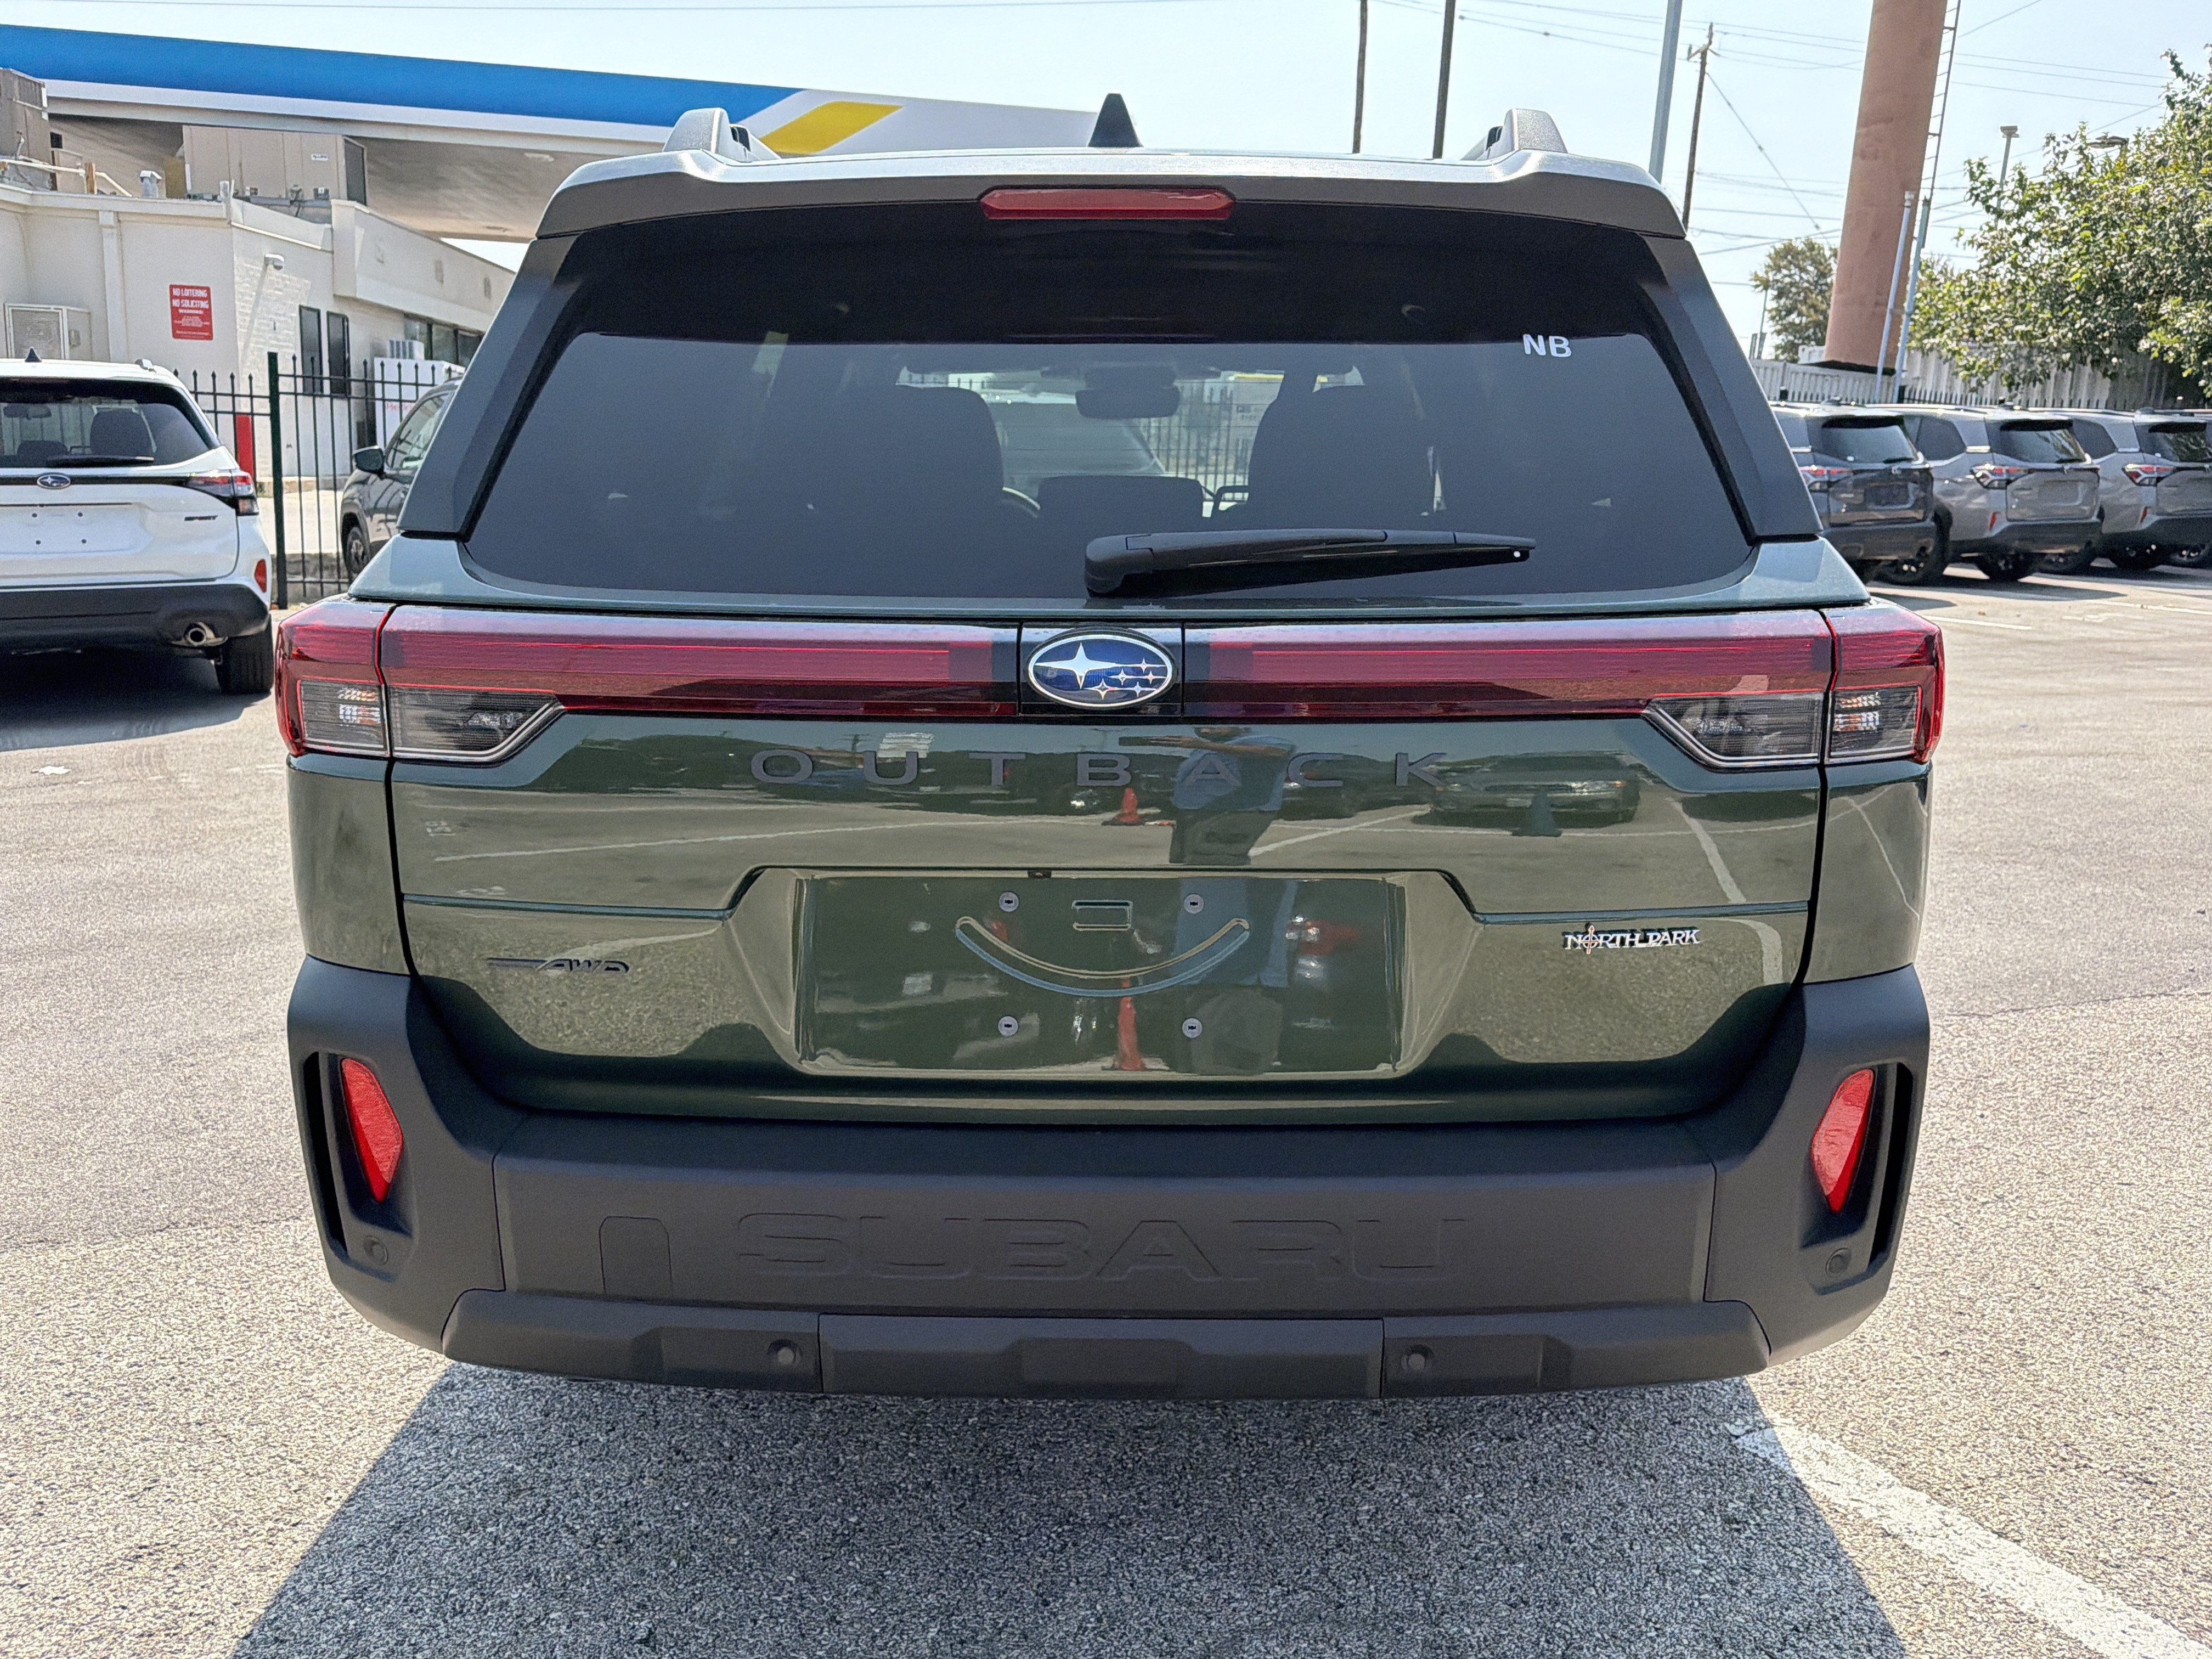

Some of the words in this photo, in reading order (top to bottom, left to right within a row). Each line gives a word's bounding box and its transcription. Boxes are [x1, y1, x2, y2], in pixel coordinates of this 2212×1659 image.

[172, 288, 180, 296] NO
[181, 288, 207, 297] LOITERING
[172, 298, 180, 307] NO
[180, 299, 209, 309] SOLICITING
[1522, 334, 1572, 358] NB
[751, 748, 1448, 788] OUTBACK
[1564, 931, 1642, 950] NORTH
[1645, 929, 1701, 947] PARK
[535, 958, 630, 973] AWD
[736, 1212, 1467, 1282] SUBARU
